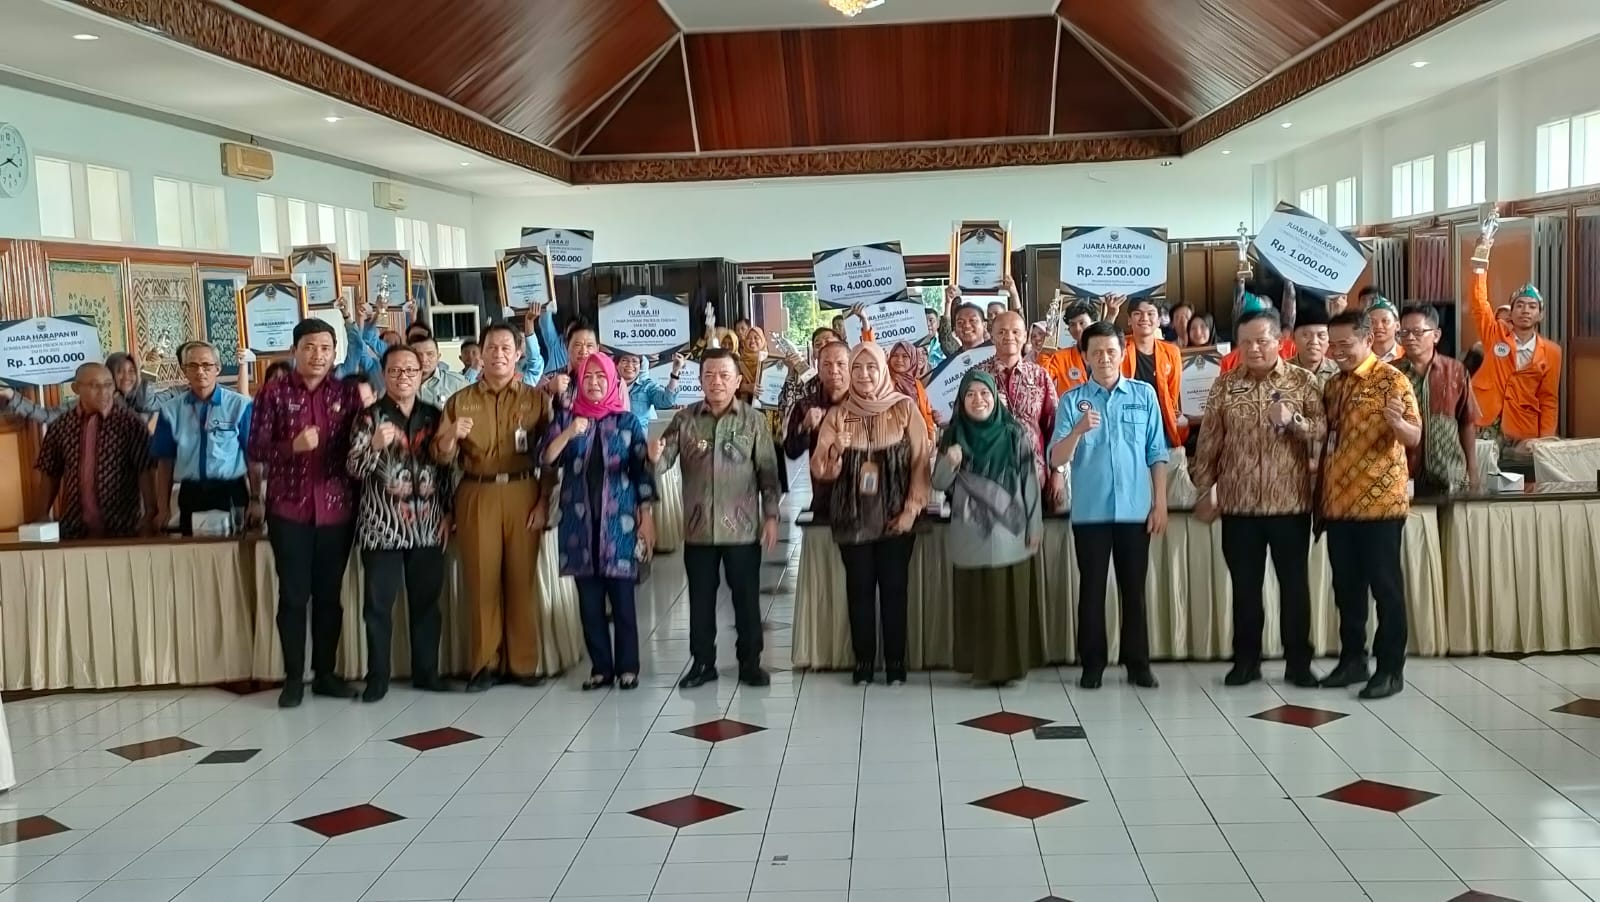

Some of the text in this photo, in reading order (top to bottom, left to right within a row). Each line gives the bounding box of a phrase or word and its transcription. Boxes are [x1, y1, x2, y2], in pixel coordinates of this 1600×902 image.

[1286, 222, 1308, 236] JUARA
[1308, 233, 1341, 255] HARAPAN
[552, 254, 582, 262] 500.000
[844, 260, 866, 268] JUARA
[1270, 238, 1286, 254] Rp.
[1290, 248, 1339, 280] 1.000.000
[1077, 266, 1150, 278] Rp. 2.500.000
[830, 276, 892, 293] Rp. 4.000.000
[877, 310, 904, 320] HARAPAN
[7, 335, 31, 343] JUARA
[33, 332, 69, 340] HARAPAN
[614, 329, 676, 340] Rp. 3.000.000
[875, 325, 916, 340] 2.000.000
[7, 352, 85, 368] Rp. 1.000.000
[944, 372, 964, 386] JUARA
